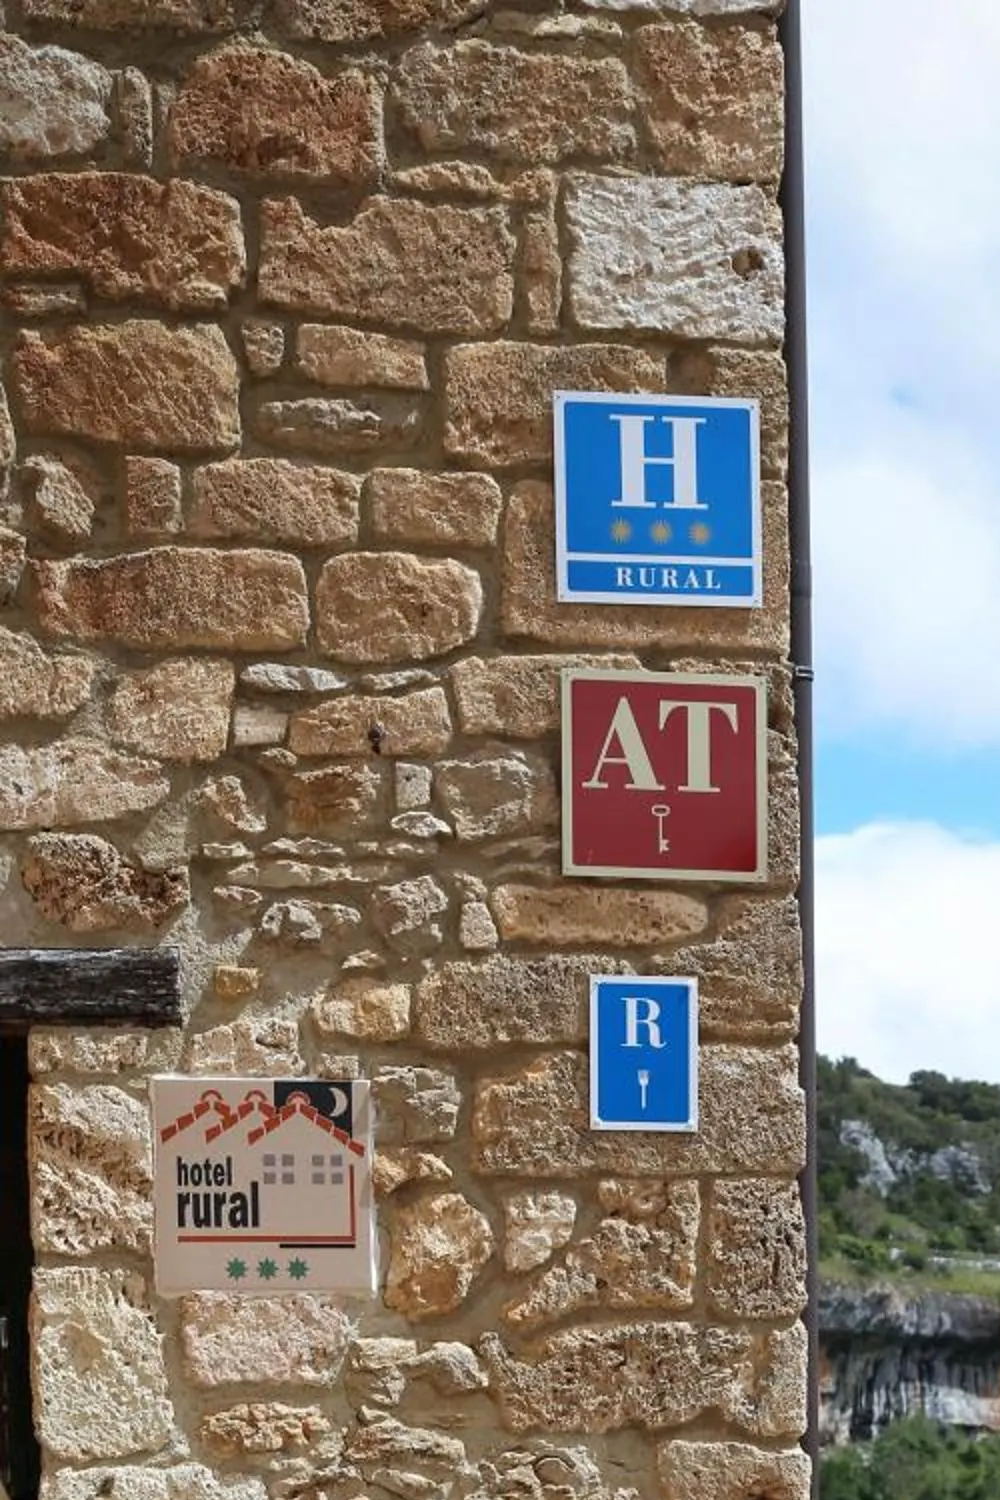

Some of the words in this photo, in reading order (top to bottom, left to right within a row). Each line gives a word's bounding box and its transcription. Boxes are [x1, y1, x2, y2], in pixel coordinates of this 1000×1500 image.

[609, 414, 708, 510] H
[616, 567, 721, 589] RURAL
[581, 696, 739, 793] AT
[620, 997, 668, 1049] R
[177, 1156, 232, 1187] hotel
[177, 1181, 259, 1228] rural
